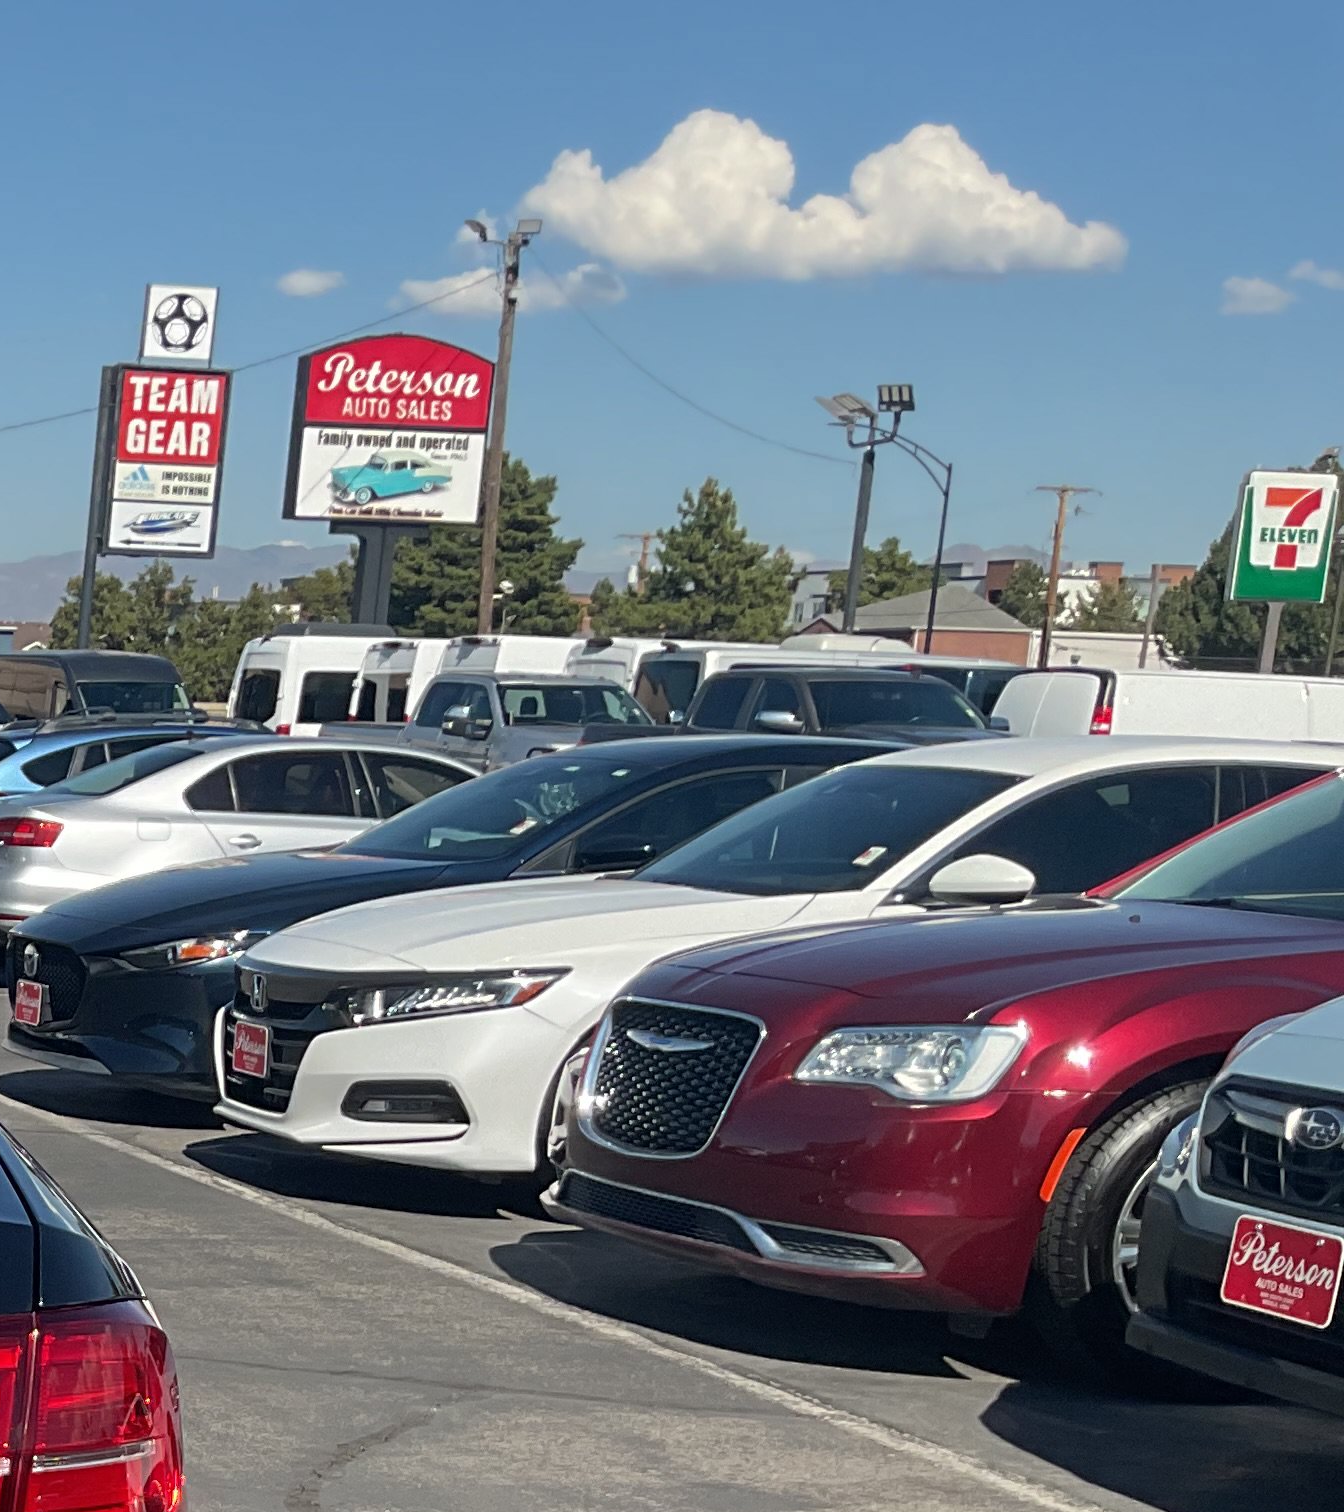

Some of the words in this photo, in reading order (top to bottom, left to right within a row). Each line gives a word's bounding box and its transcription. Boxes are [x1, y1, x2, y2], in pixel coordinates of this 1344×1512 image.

[317, 352, 480, 399] Peterson
[129, 376, 220, 414] TEAM
[342, 397, 389, 418] AUTO
[395, 399, 452, 421] SALES
[126, 418, 211, 456] GEAR
[317, 430, 353, 448] Family
[356, 432, 393, 448] owned
[396, 431, 416, 448] and
[419, 434, 470, 451] operated
[161, 471, 212, 483] IMPOSSIBLE
[161, 485, 170, 495] IS
[172, 486, 209, 496] NOTHING
[1265, 487, 1323, 568] 7
[1233, 1231, 1335, 1291] Peterson
[1255, 1277, 1277, 1291] AUTO
[1278, 1282, 1304, 1299] SALES
